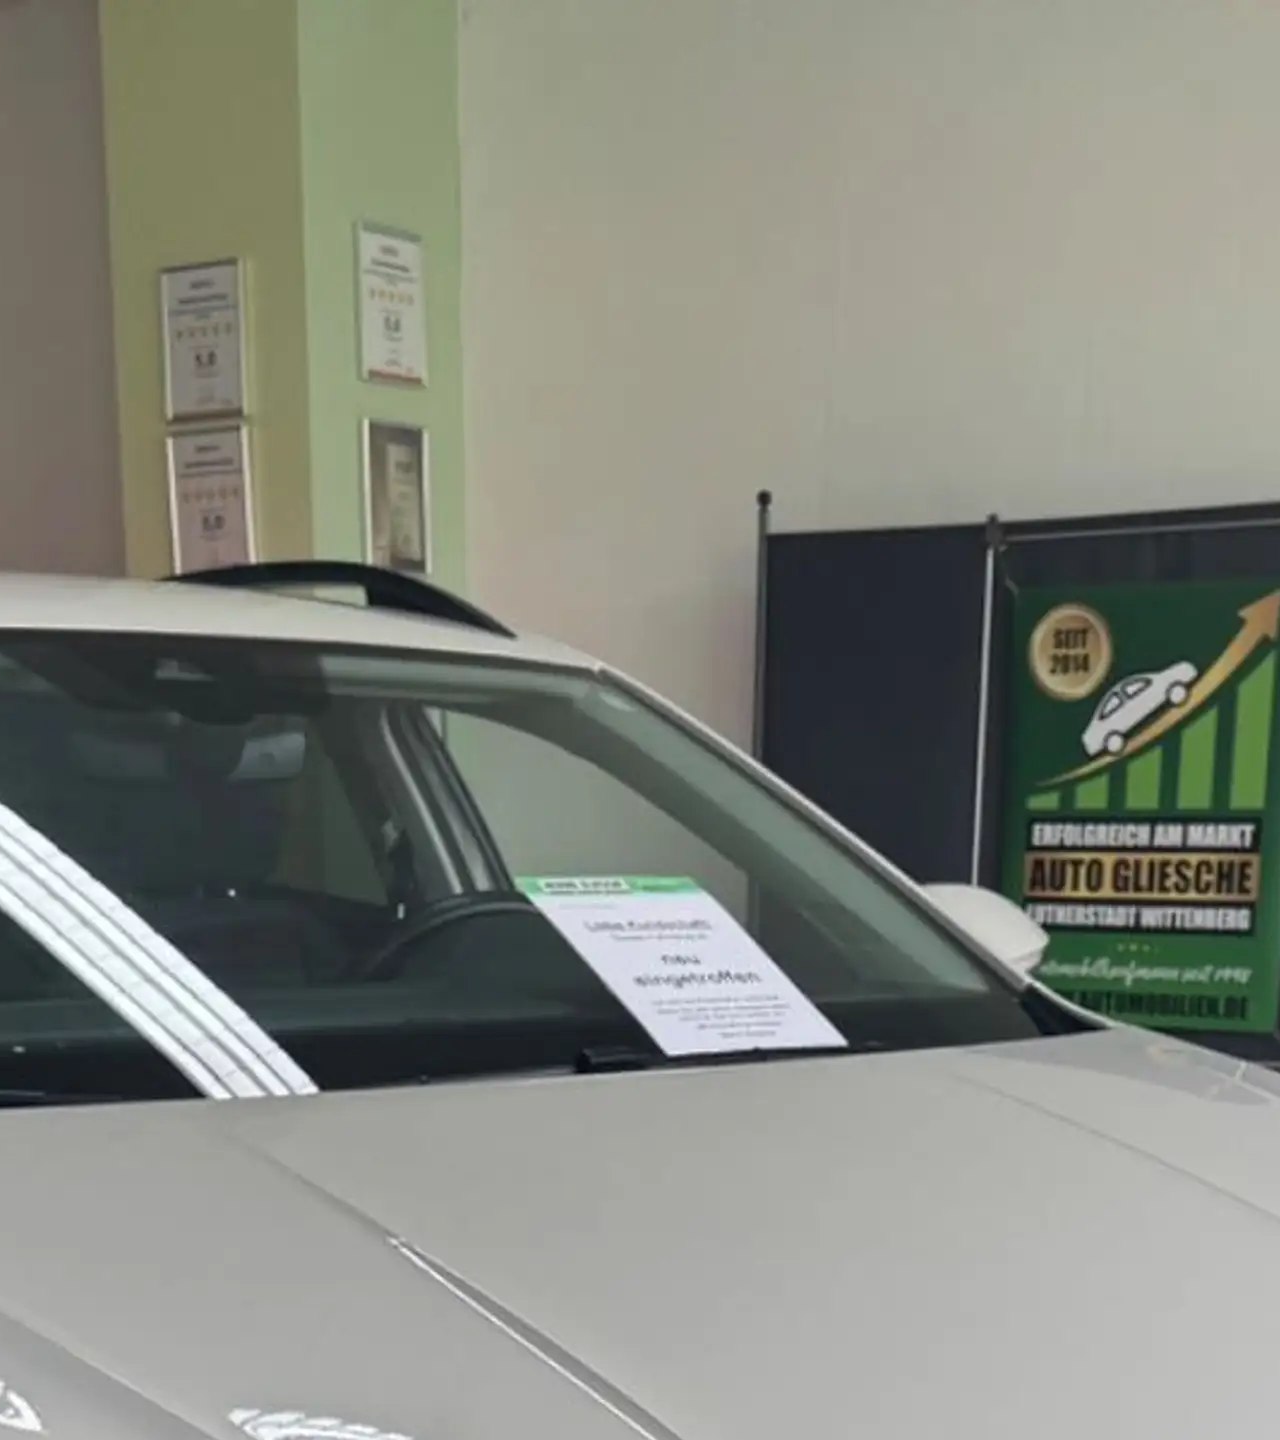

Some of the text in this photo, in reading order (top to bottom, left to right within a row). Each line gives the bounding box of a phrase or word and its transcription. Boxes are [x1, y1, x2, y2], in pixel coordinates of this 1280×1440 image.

[1053, 628, 1089, 650] SEIT
[1050, 652, 1090, 676] 2014
[1031, 822, 1256, 849] ERFOLGREICH AM MARKT
[1028, 857, 1253, 894] AUTO GLIESCHE
[1139, 906, 1252, 930] WITTENBERG
